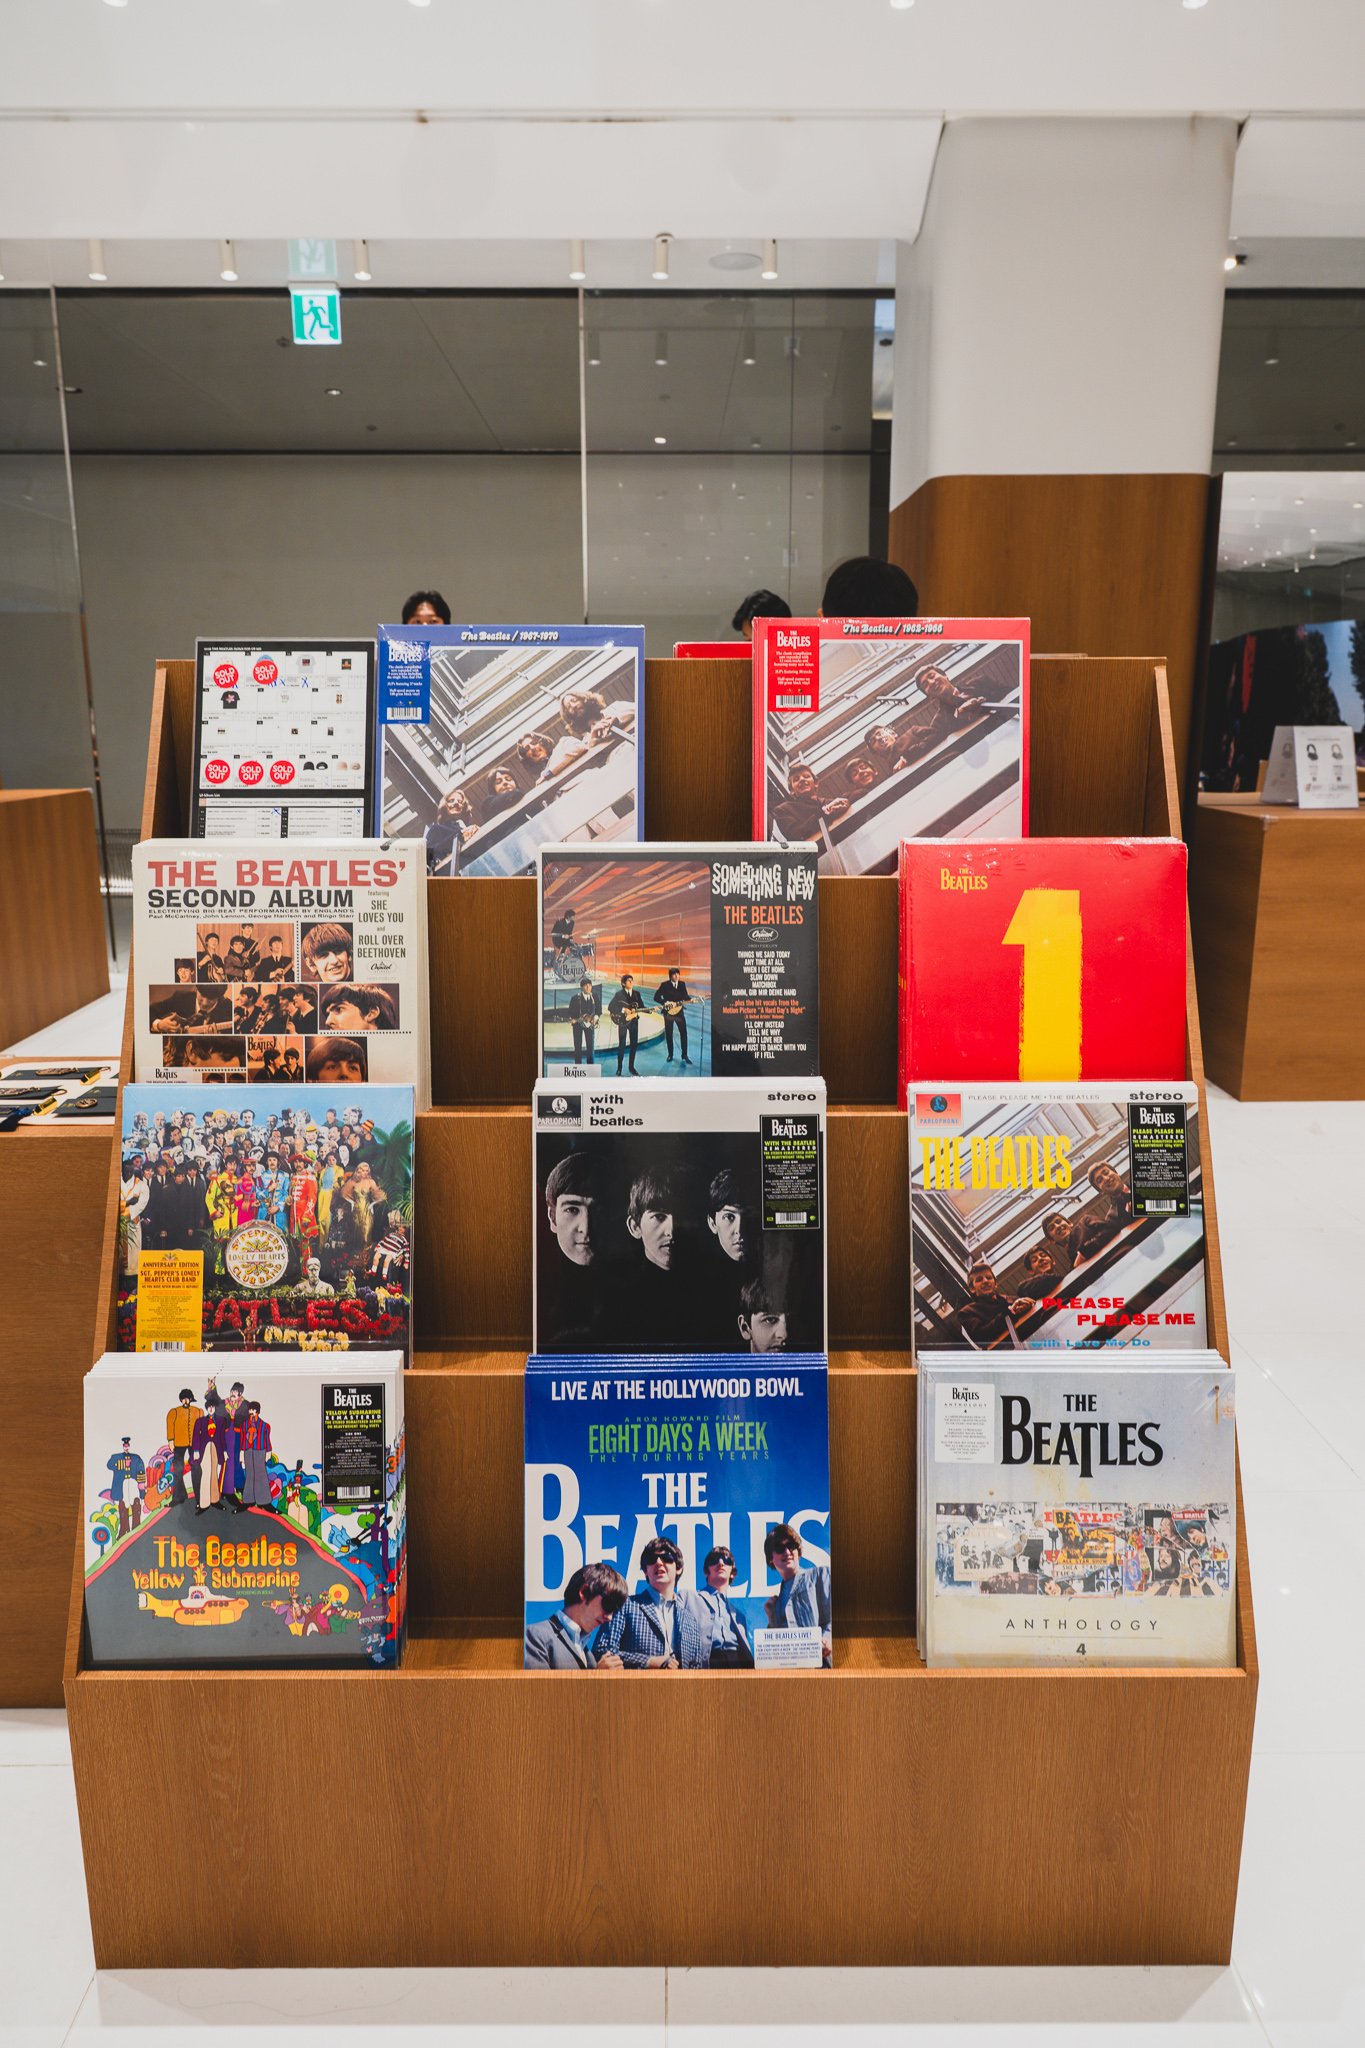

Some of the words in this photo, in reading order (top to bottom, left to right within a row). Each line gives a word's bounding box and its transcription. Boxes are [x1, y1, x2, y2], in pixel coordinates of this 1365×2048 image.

[843, 624, 860, 634] The
[862, 624, 893, 634] Beatles
[903, 624, 943, 634] 1962-1966
[461, 631, 477, 641] The
[479, 631, 510, 641] Beatles
[520, 631, 559, 641] 1967-1970
[777, 631, 811, 649] BEATLES
[215, 668, 235, 679] SOLD
[255, 664, 275, 675] SOLD
[218, 674, 235, 685] OUT
[258, 671, 274, 681] OUT
[208, 764, 228, 774] SOLD
[209, 771, 226, 779] OUT
[241, 765, 261, 774] SOLD
[272, 765, 292, 774] SOLD
[242, 772, 260, 780] OUT
[274, 772, 291, 780] OUT
[148, 860, 217, 888] THE
[236, 860, 406, 888] BEATLES'
[713, 862, 782, 885] SOMETHING
[788, 866, 815, 887] NEW
[940, 868, 988, 893] BEATLES
[712, 879, 782, 901] SOMETHING
[787, 880, 814, 901] NEW
[148, 889, 256, 908] SECOND
[268, 889, 353, 908] ALBUM
[371, 900, 387, 910] SHE
[359, 913, 384, 922] LOVES
[387, 913, 404, 922] YOU
[724, 906, 748, 924] THE
[752, 906, 804, 924] BEATLES
[359, 935, 379, 945] ROLL
[382, 935, 404, 945] OVER
[358, 948, 406, 958] BEETHOVEN
[1001, 889, 1082, 1082] 1
[156, 1068, 178, 1080] BEATLES
[564, 1067, 586, 1078] BEATLES
[590, 1094, 623, 1104] with
[768, 1092, 816, 1101] stereo
[1130, 1091, 1183, 1100] stereo
[590, 1105, 614, 1115] the
[539, 1117, 581, 1126] PARLOPHONE
[590, 1116, 643, 1126] beatles
[1140, 1107, 1176, 1127] BEATLES
[772, 1119, 808, 1138] BEATLES
[918, 1135, 964, 1191] THE
[971, 1135, 1072, 1191] BEATLES
[1042, 1298, 1125, 1309] PLEASE
[1077, 1314, 1159, 1326] PLEASE
[1165, 1314, 1196, 1326] ME
[1031, 1339, 1060, 1347] with
[1066, 1339, 1100, 1347] Love
[1106, 1339, 1126, 1347] Me
[1132, 1339, 1150, 1347] Do
[552, 1381, 587, 1400] LIVE
[591, 1380, 613, 1400] AT
[614, 1380, 645, 1399] THE
[650, 1378, 750, 1399] HOLLYWOOD
[755, 1377, 804, 1397] BOWL
[334, 1389, 372, 1409] BEATLES
[952, 1388, 980, 1402] BEATLES
[1063, 1394, 1097, 1412] THE
[589, 1424, 641, 1454] EIGHT
[647, 1424, 693, 1453] DAYS
[698, 1423, 710, 1452] A
[716, 1422, 768, 1451] WEEK
[1000, 1396, 1163, 1478] BEATLES
[590, 1455, 617, 1463] THE
[632, 1452, 704, 1462] TOURING
[719, 1451, 769, 1461] YEARS
[642, 1472, 707, 1508] THE
[524, 1463, 830, 1602] BEATLES
[153, 1535, 199, 1568] The
[206, 1535, 297, 1568] Beatles
[132, 1567, 185, 1589] Yellow
[212, 1567, 300, 1589] Submarine
[1006, 1618, 1157, 1631] ANTHOLOGY
[1076, 1643, 1087, 1655] 4
